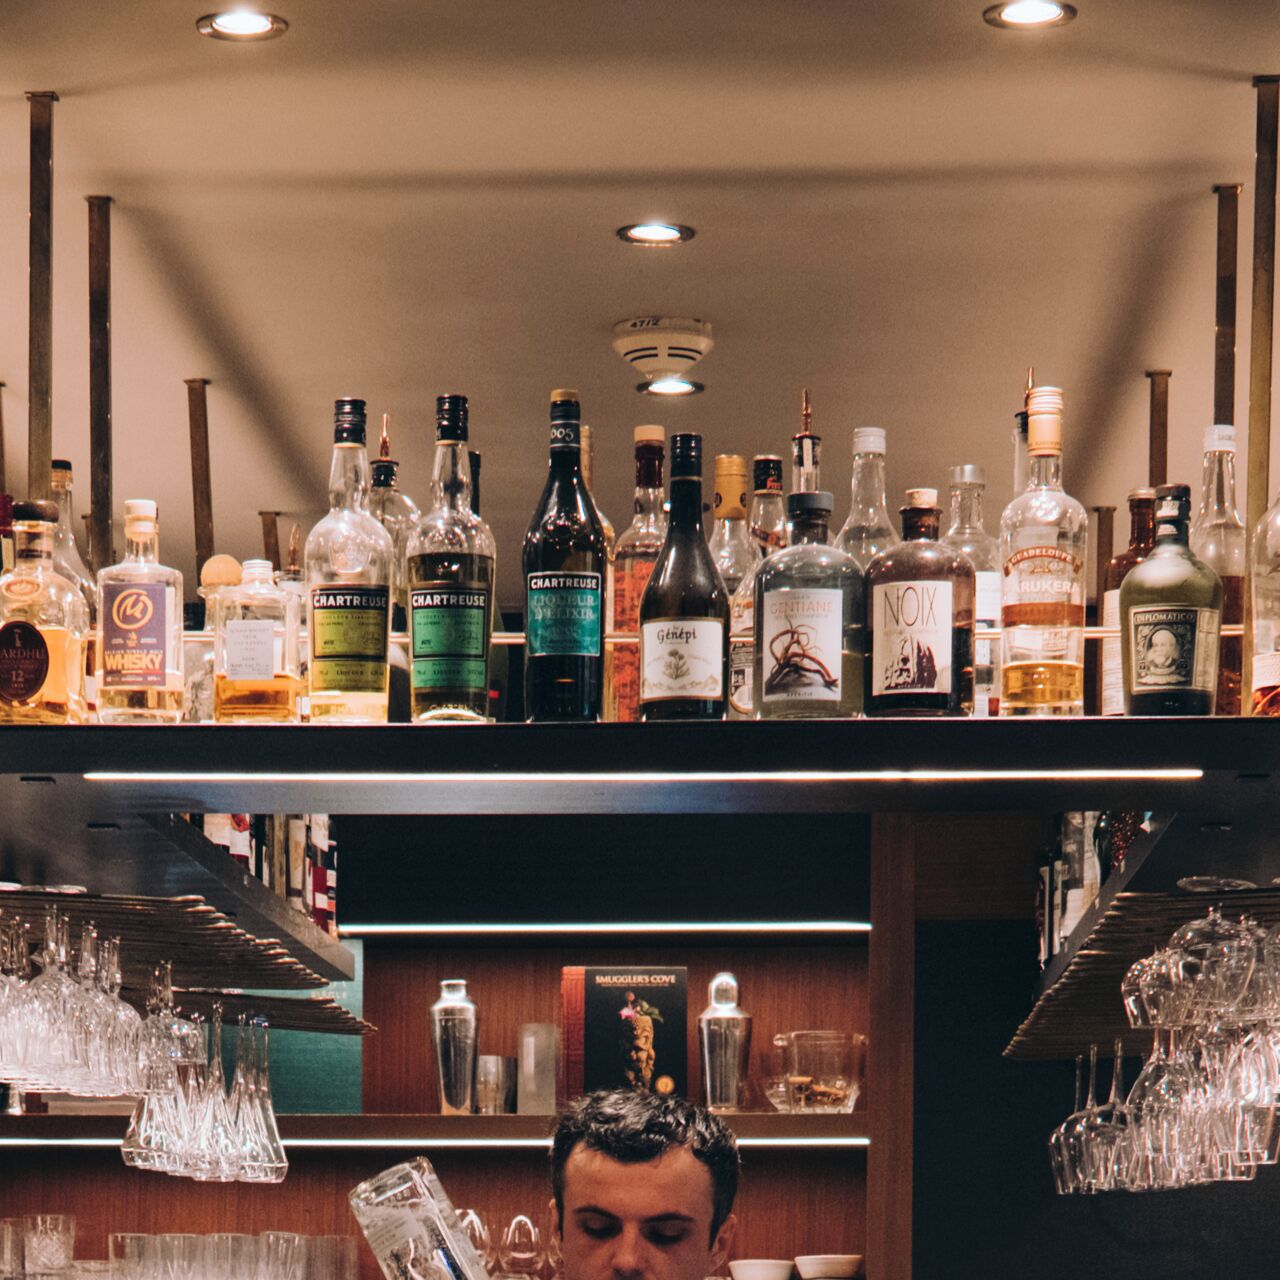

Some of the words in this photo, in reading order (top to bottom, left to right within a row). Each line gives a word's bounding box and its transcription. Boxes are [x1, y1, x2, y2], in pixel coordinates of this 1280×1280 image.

[1011, 548, 1073, 564] GUADELOUPE
[531, 578, 597, 589] CHARTREUSE
[313, 595, 387, 608] CHARTREUSE
[412, 595, 485, 606] CHARTREUSE
[770, 600, 833, 614] GENTIANE
[884, 586, 937, 629] NOIX
[657, 627, 697, 644] Génépi
[105, 654, 163, 671] WHISKY
[11, 671, 25, 681] 12
[596, 975, 649, 984] SMUGGLER'S
[650, 975, 676, 983] COVE
